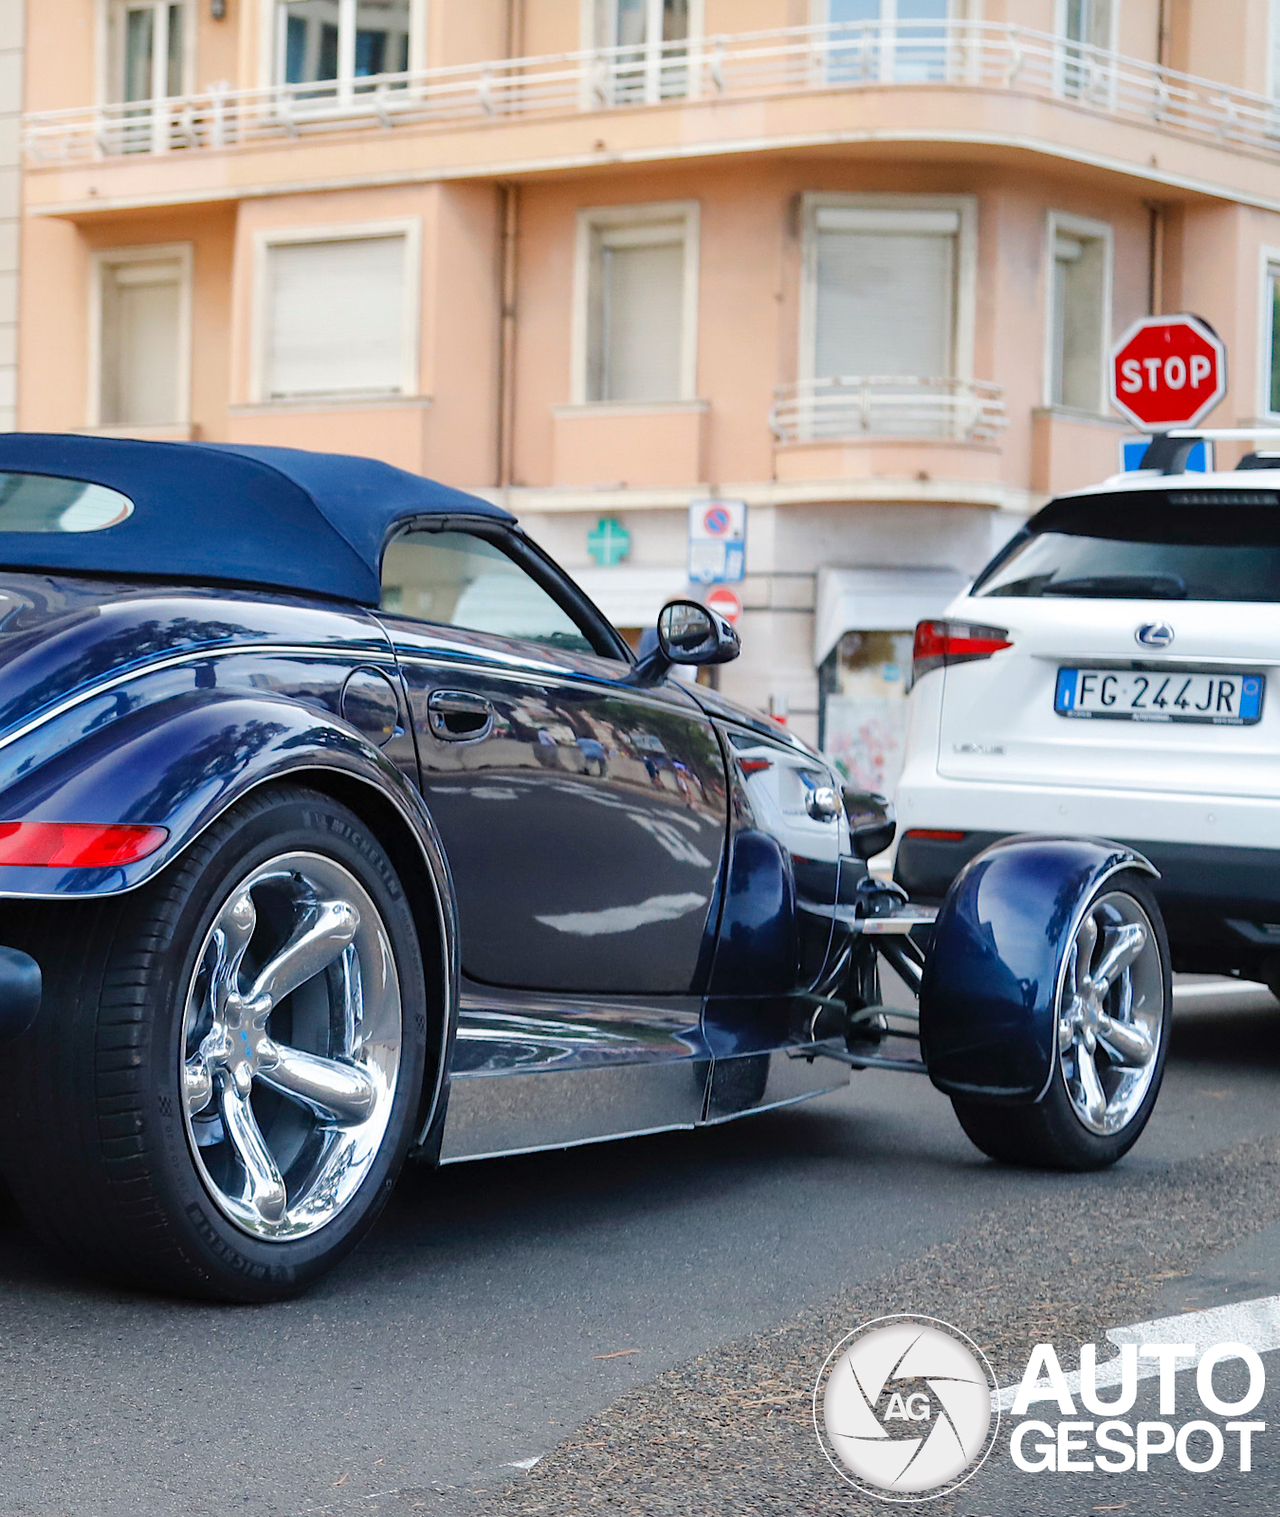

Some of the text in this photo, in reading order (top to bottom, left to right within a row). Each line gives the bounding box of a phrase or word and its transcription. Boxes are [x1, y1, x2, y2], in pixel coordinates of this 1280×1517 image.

[1121, 354, 1212, 394] STOP
[1080, 675, 1235, 713] FG 244JR
